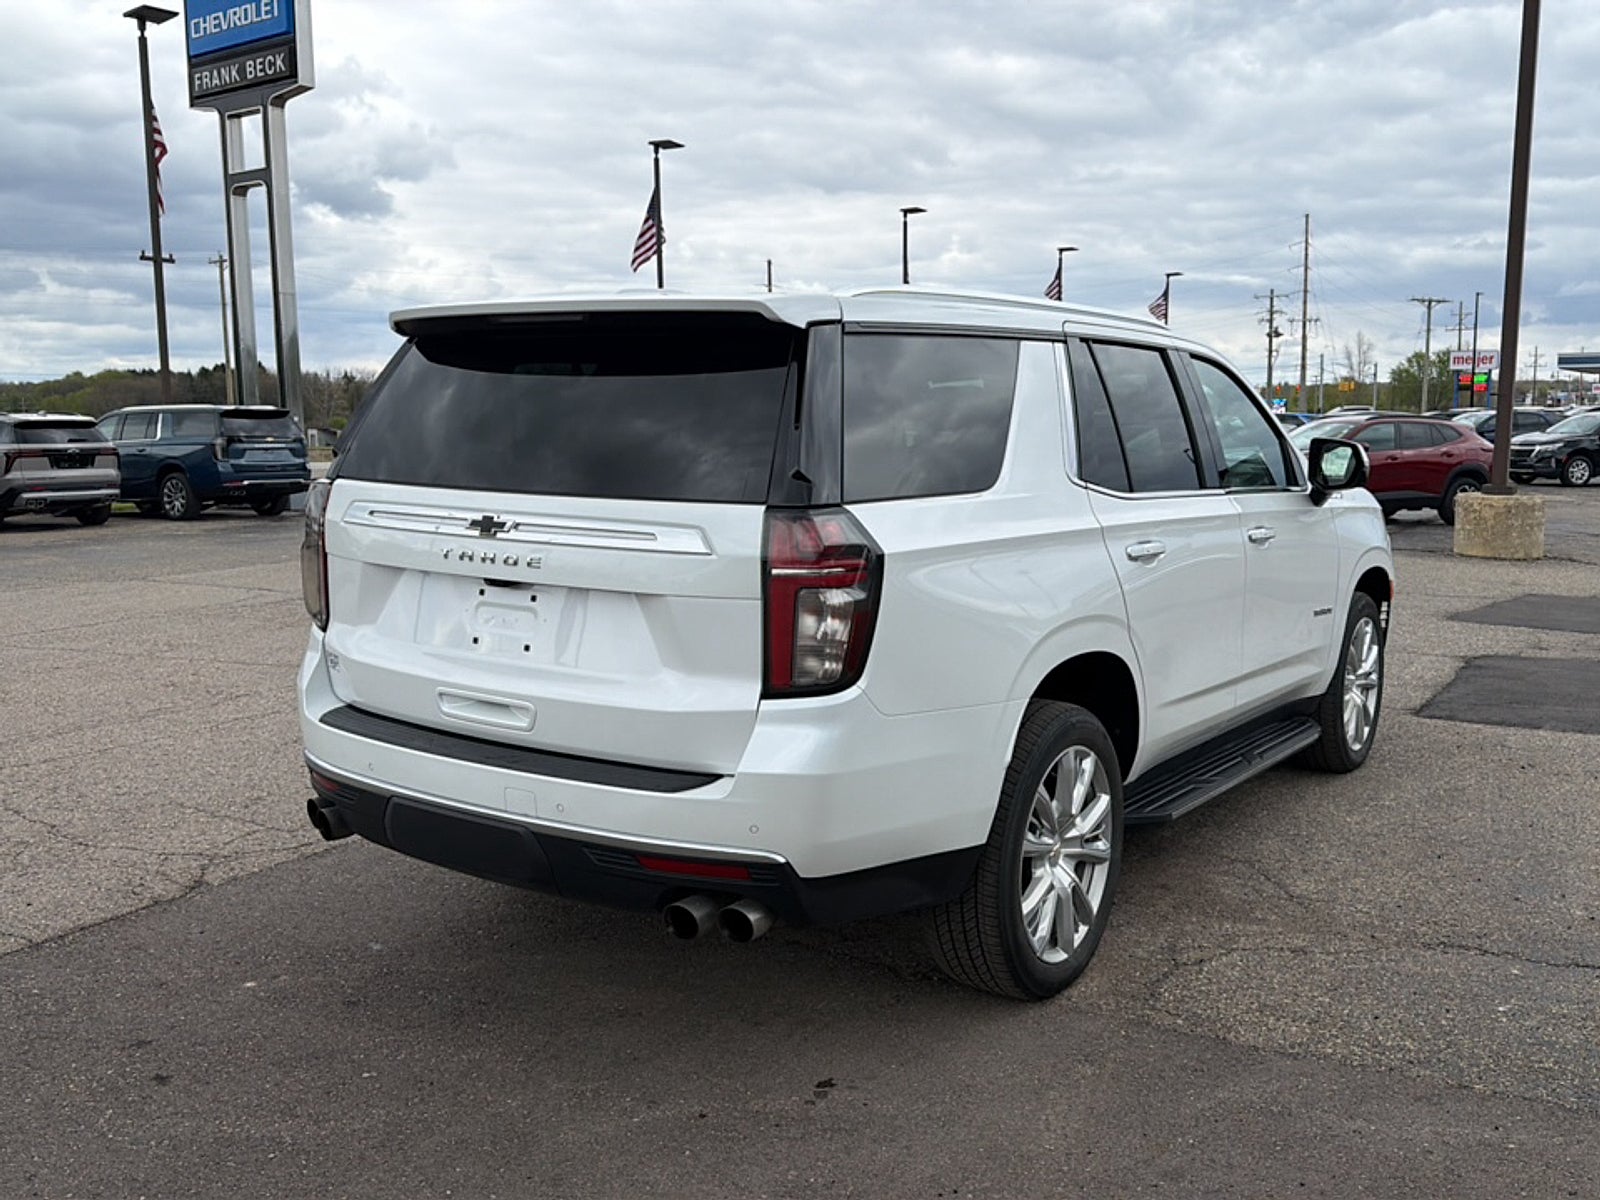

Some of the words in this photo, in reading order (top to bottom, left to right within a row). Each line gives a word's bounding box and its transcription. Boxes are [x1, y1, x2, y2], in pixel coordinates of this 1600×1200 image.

[191, 0, 278, 38] CHEVROLET
[194, 63, 240, 92] FRANK
[246, 53, 286, 80] BECK
[1452, 353, 1495, 368] mejer
[441, 547, 542, 570] TAHOE
